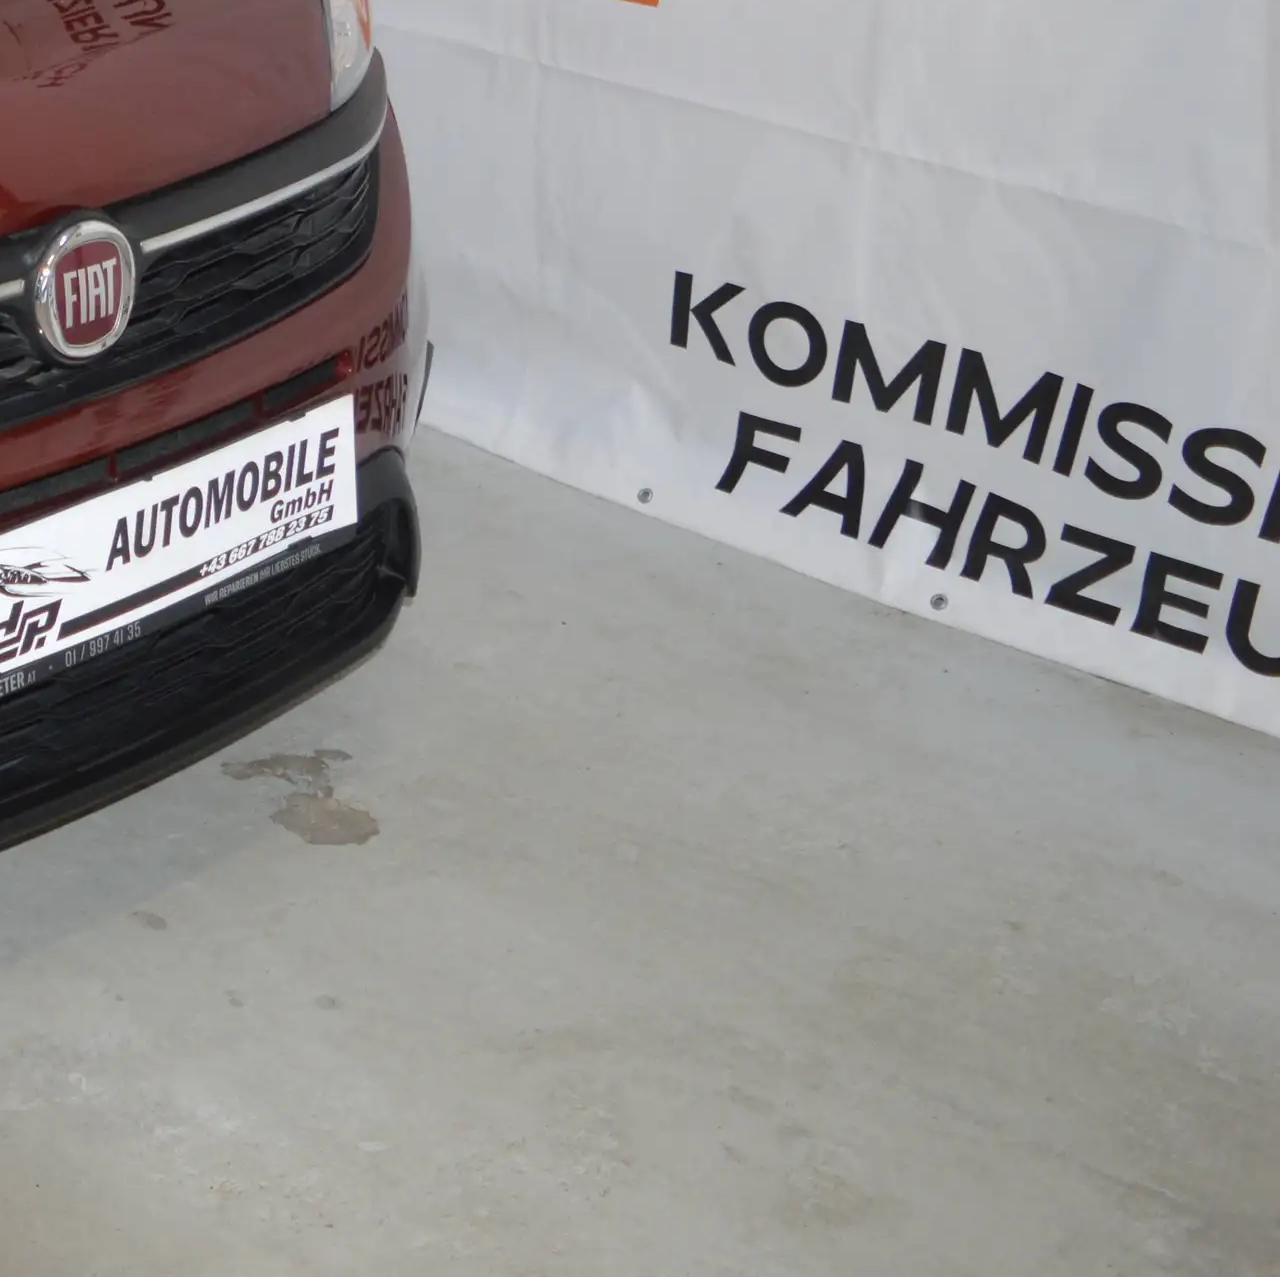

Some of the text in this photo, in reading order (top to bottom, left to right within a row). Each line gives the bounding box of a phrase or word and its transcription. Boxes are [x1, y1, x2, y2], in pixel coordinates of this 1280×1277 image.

[62, 257, 118, 329] FIAT
[106, 427, 340, 572] AUTOMOBILE
[270, 479, 334, 524] GmbH
[199, 552, 227, 577] +43
[228, 538, 257, 564] 667
[285, 517, 307, 536] 23
[309, 510, 329, 528] 75
[714, 410, 1280, 678] FAHRZEU
[89, 635, 110, 657] 997
[127, 621, 141, 641] 35
